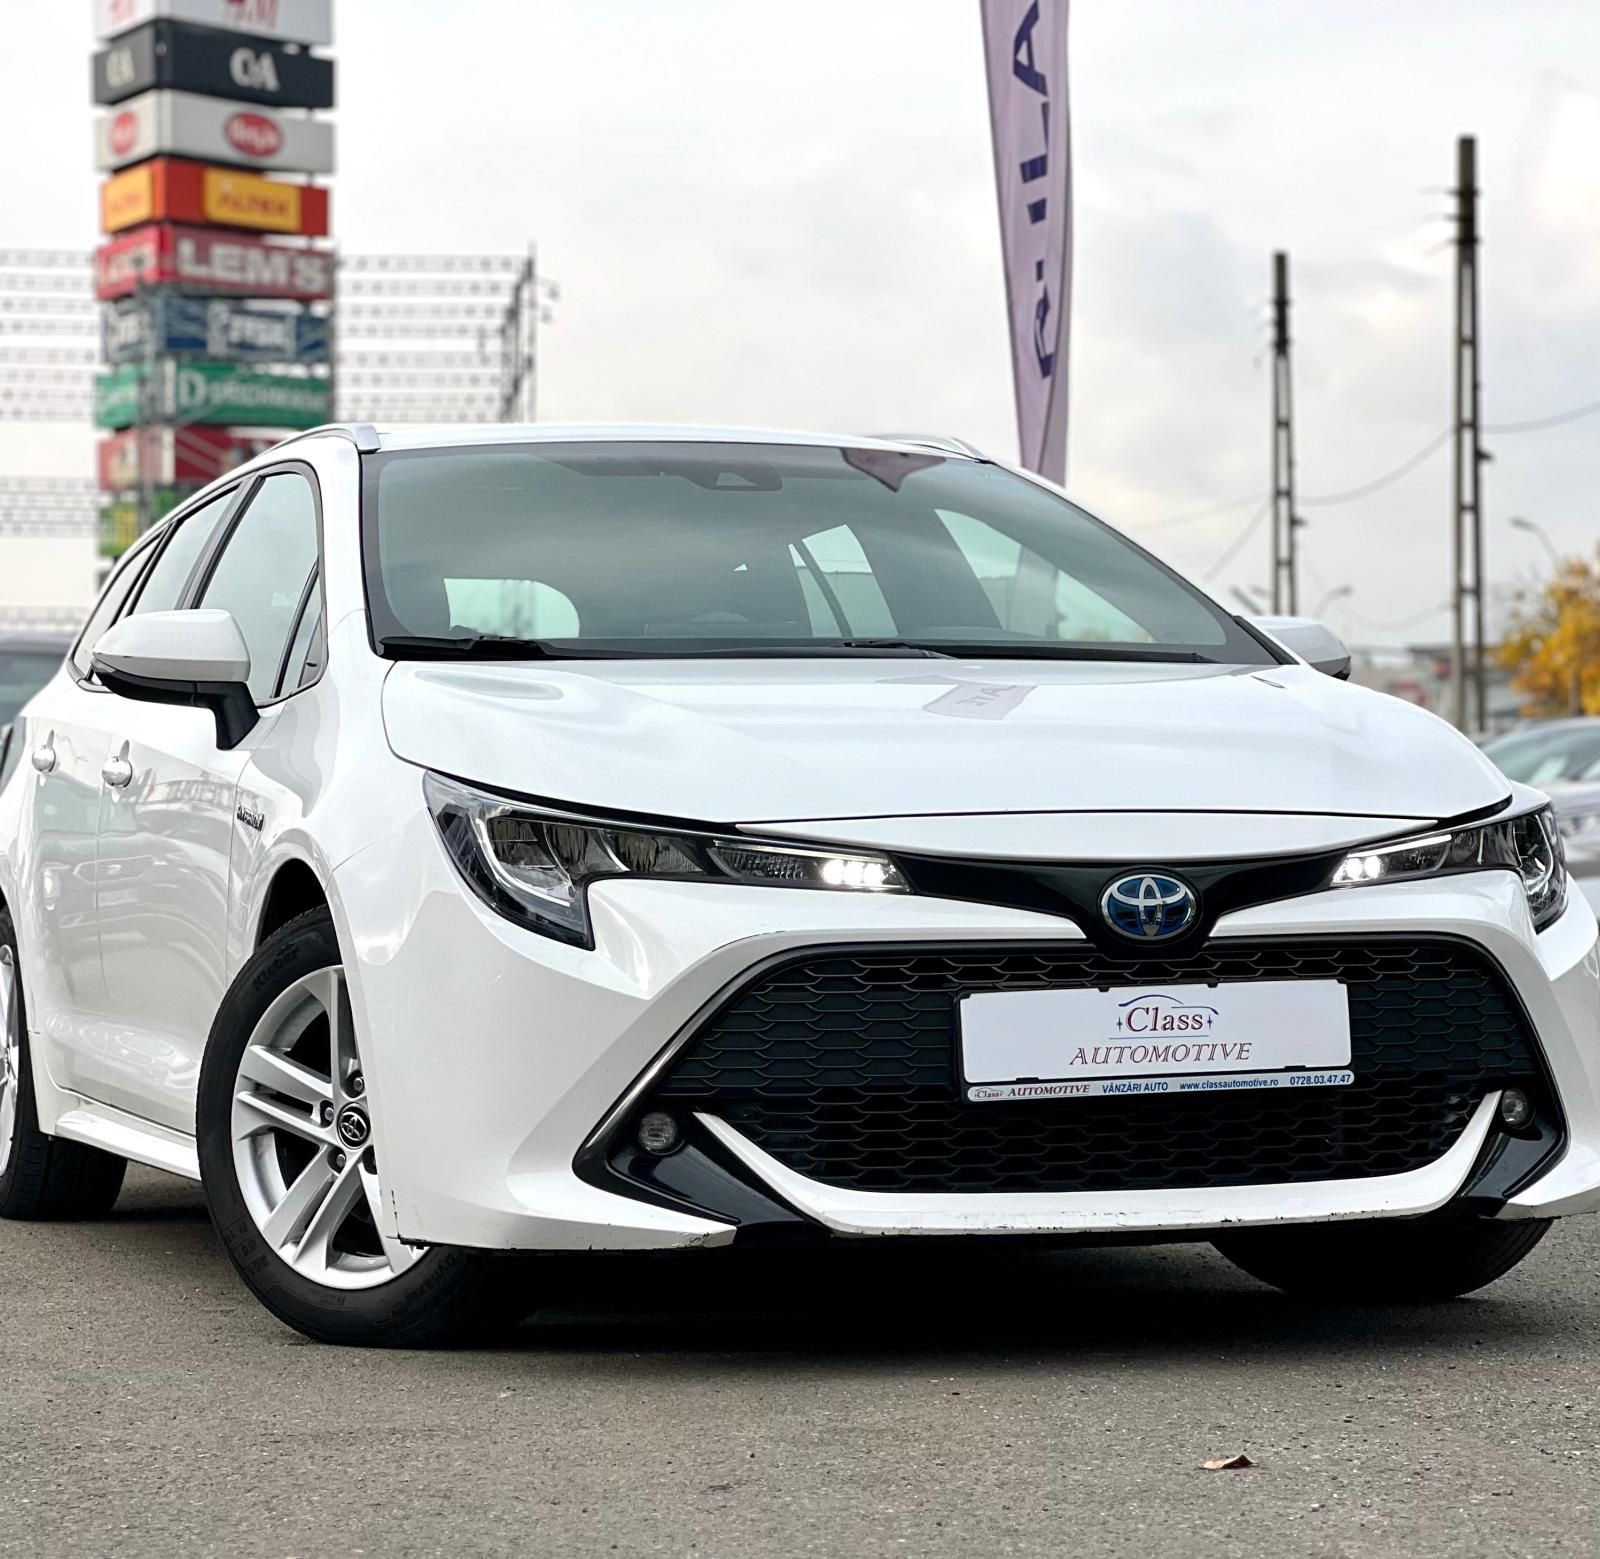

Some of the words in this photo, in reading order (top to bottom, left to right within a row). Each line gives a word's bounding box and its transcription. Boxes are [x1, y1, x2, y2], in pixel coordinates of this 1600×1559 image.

[1126, 1006, 1203, 1032] Class
[1069, 1043, 1252, 1066] AUTOMOTIVE
[976, 1089, 1000, 1099] Class
[1008, 1085, 1090, 1096] AUTOMOTIVE
[1143, 1082, 1168, 1092] AUTO
[1180, 1079, 1279, 1090] www.classautomotive.ro
[1290, 1075, 1351, 1086] 0728.03.47.47
